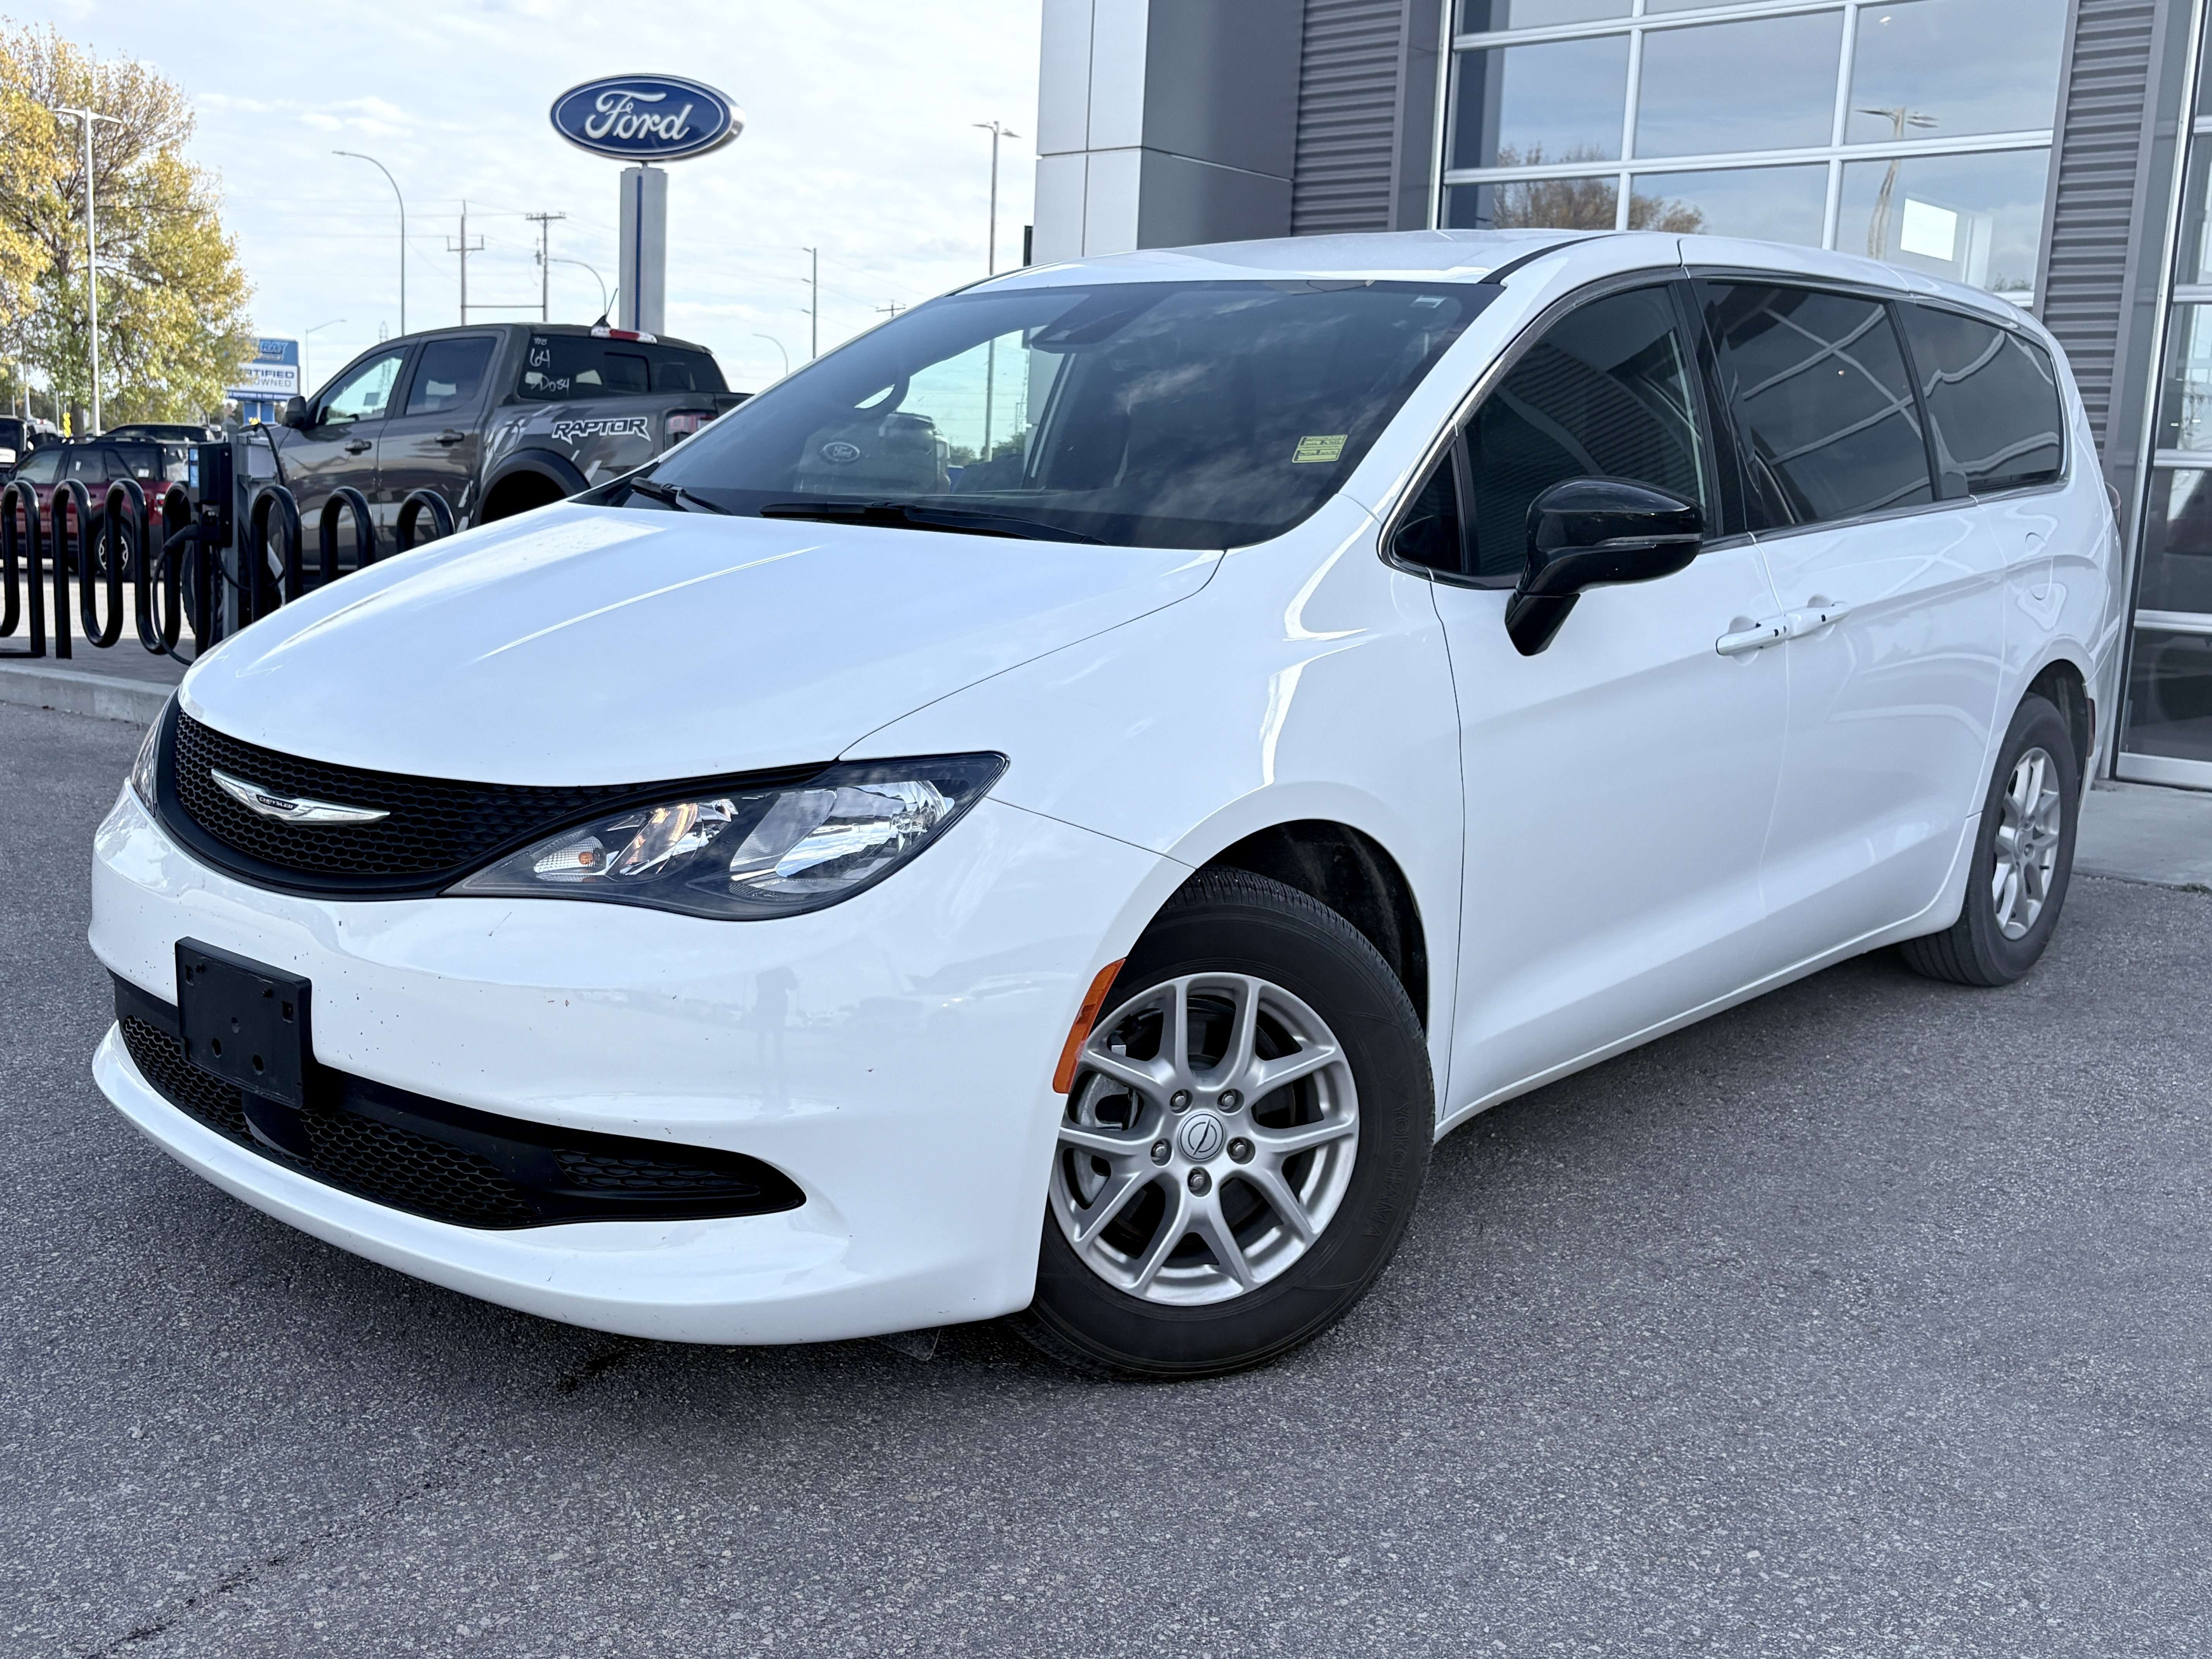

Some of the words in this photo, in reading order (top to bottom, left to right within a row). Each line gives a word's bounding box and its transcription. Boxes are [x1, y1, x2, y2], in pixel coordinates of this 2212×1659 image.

[585, 90, 694, 140] Ford
[529, 348, 550, 368] 64
[241, 368, 295, 379] RTIFIED
[551, 417, 651, 445] RAPTOR
[833, 445, 853, 458] Ford
[259, 797, 294, 809] CHRYSLER
[1361, 1102, 1410, 1237] YOKOHAMA
